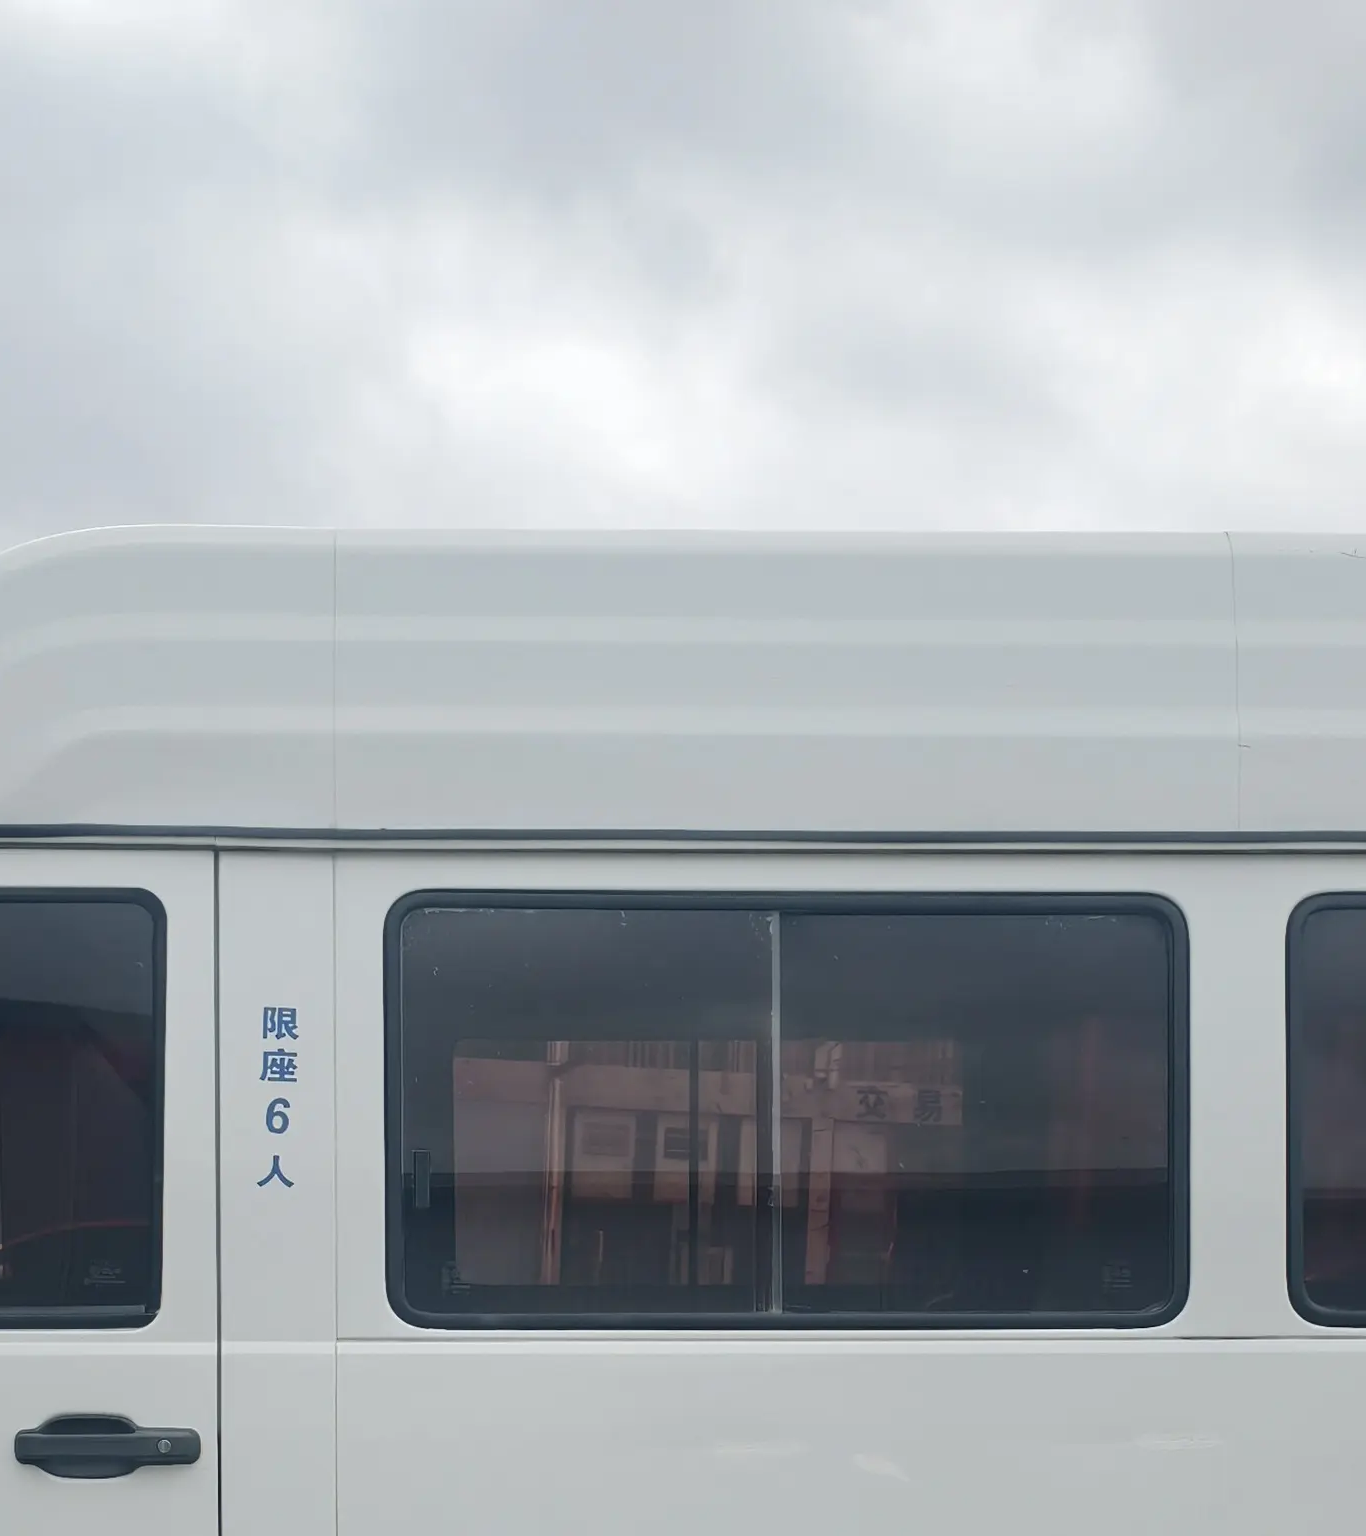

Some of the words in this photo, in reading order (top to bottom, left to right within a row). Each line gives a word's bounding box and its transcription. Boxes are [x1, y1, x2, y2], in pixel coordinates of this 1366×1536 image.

[257, 1006, 299, 1188] 限座6人
[854, 1085, 944, 1123] 交易
